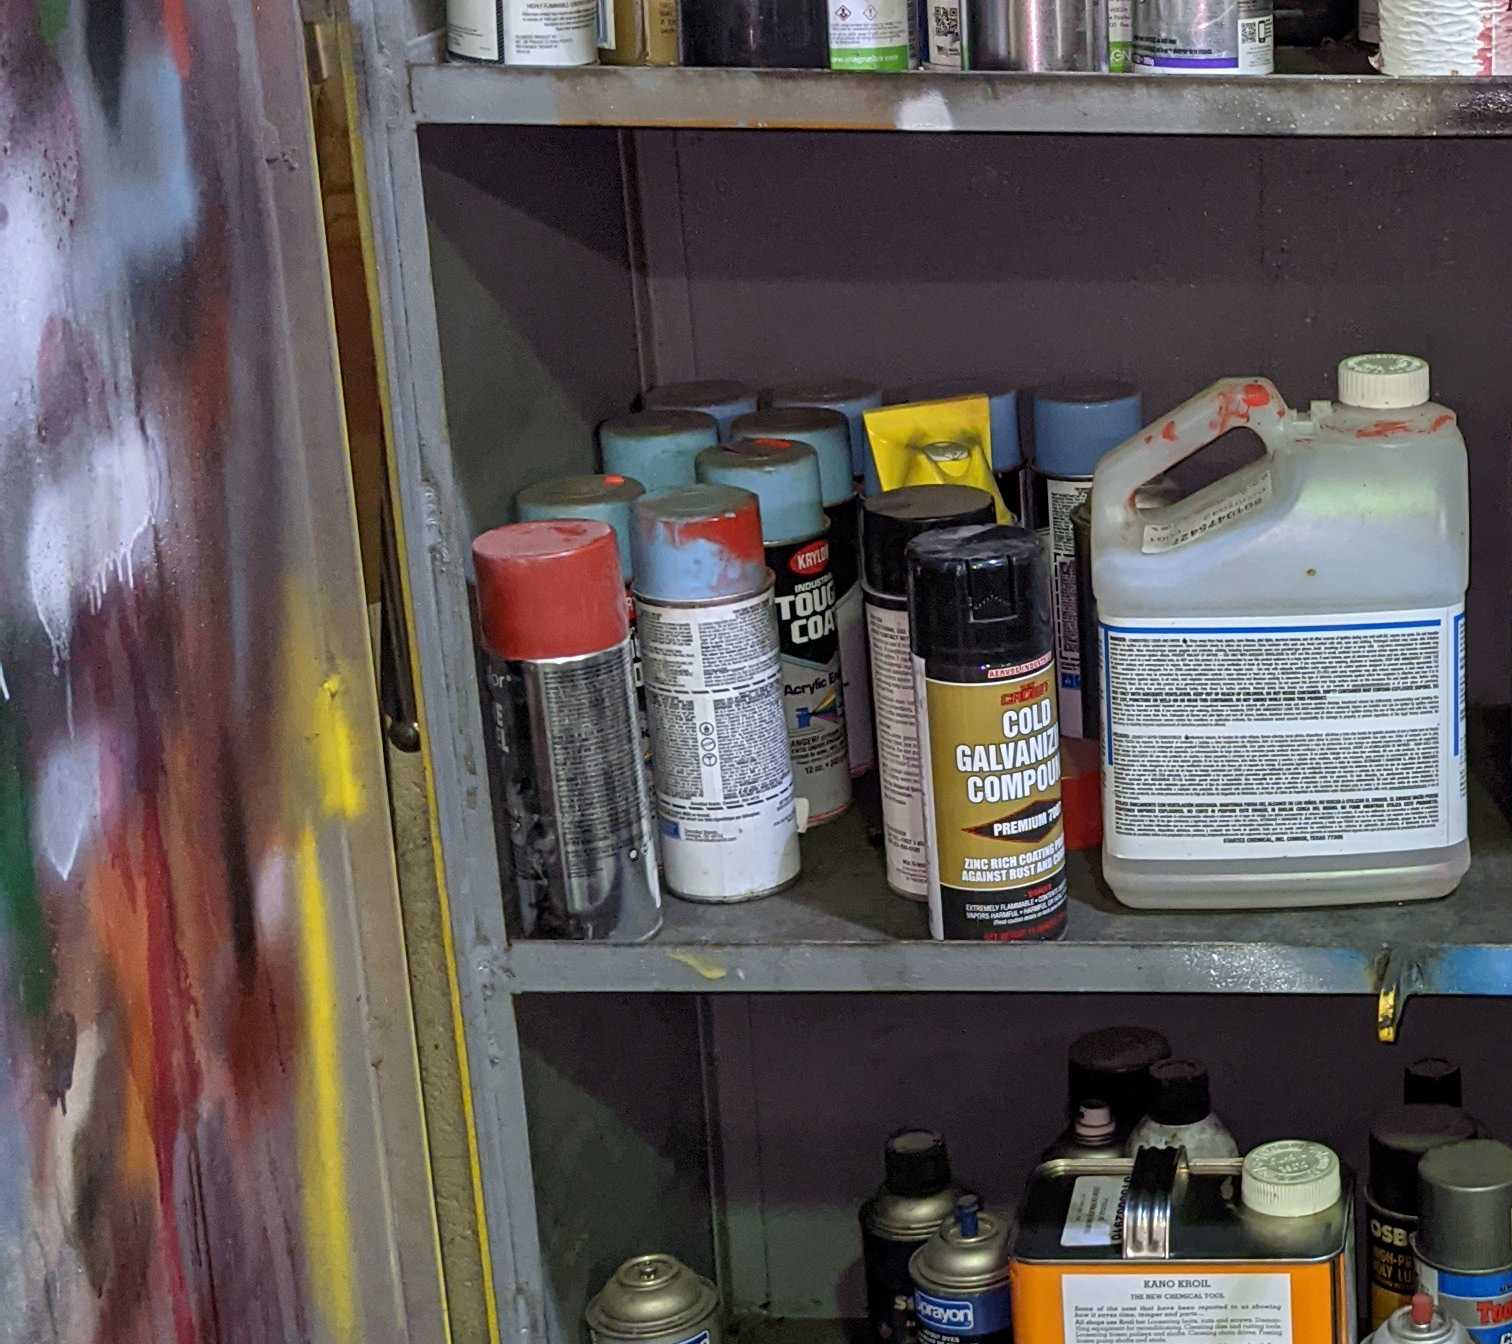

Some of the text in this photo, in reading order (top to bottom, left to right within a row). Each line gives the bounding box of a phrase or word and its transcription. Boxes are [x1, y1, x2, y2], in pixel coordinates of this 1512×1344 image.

[784, 676, 827, 696] Acrylic
[1003, 697, 1051, 739] COLD
[993, 811, 1047, 837] PREMIUM
[965, 857, 988, 870] ZINC
[991, 857, 1017, 870] RICH
[962, 869, 1008, 882] AGAINST
[1009, 865, 1036, 880] RUST
[1143, 1279, 1211, 1288] KANO KROIL
[1164, 1292, 1203, 1300] CHEMICAL
